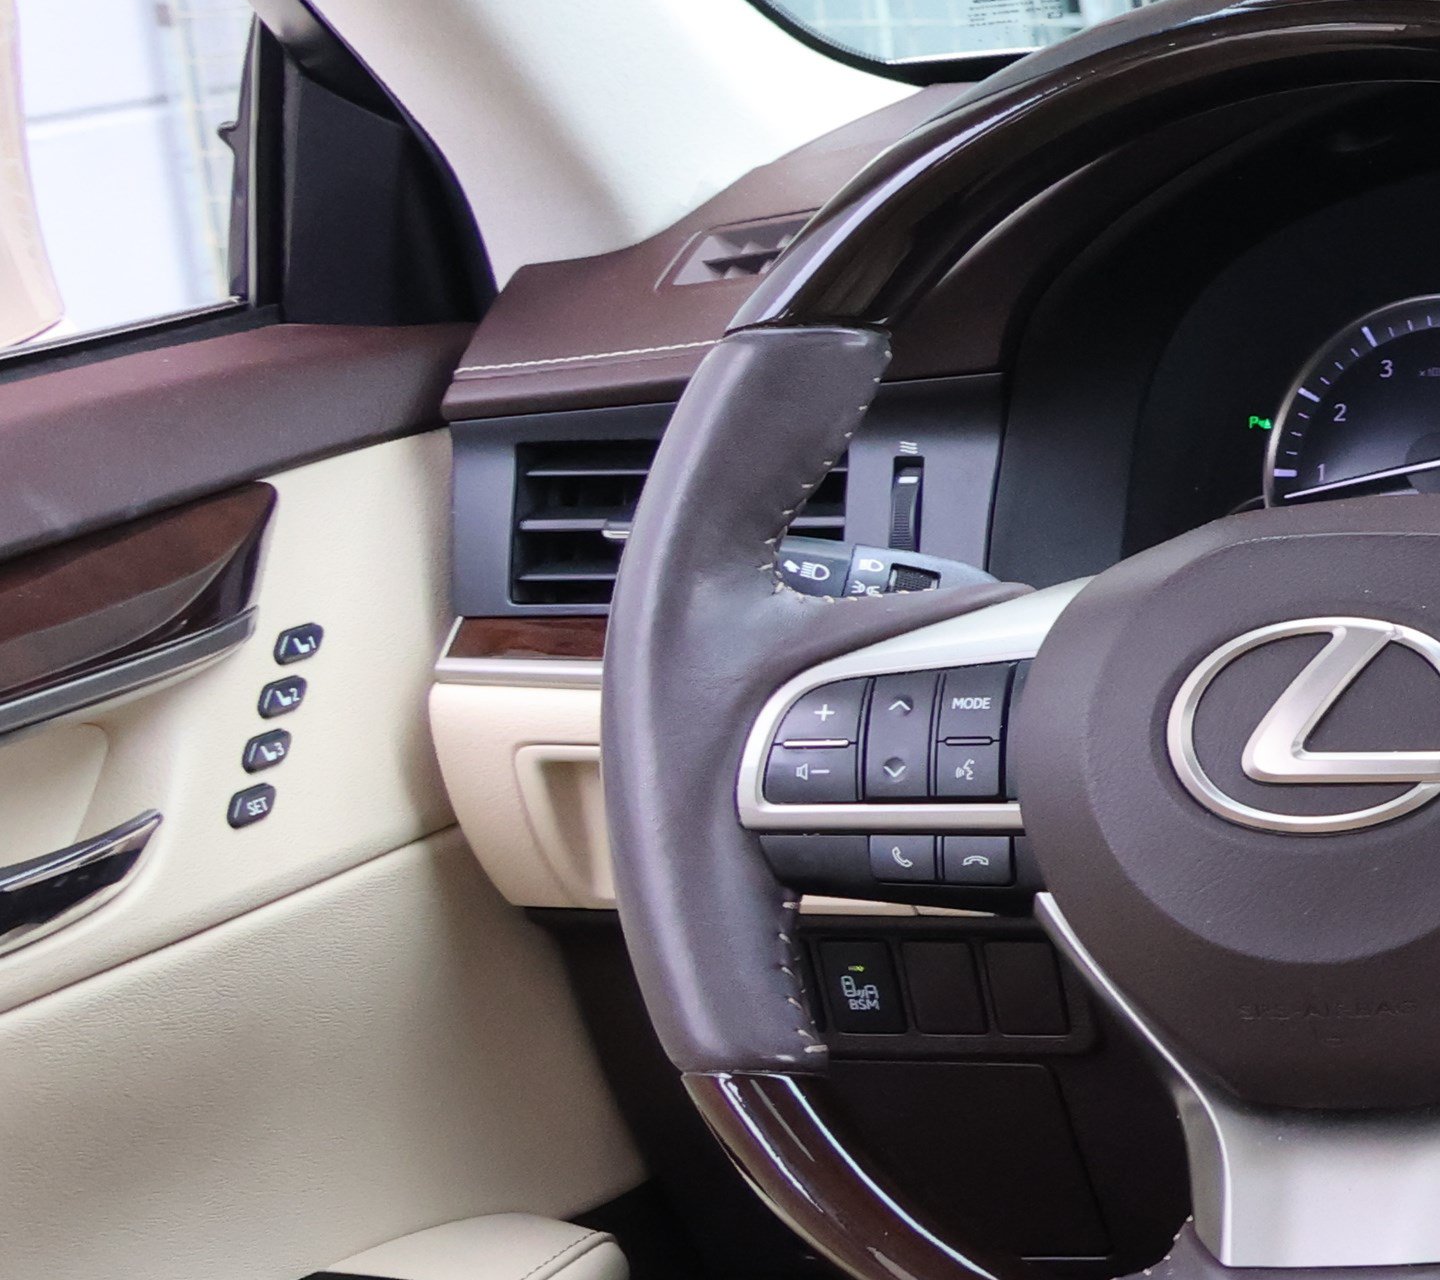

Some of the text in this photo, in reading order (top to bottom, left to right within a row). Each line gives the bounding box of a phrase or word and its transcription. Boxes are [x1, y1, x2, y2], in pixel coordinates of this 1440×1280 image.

[1379, 358, 1393, 378] 3
[1332, 402, 1348, 423] 2
[1316, 462, 1326, 481] 1
[289, 687, 301, 704] 2
[951, 697, 991, 711] MODE
[273, 740, 286, 758] 3
[246, 796, 269, 815] SET
[848, 999, 880, 1011] BSM
